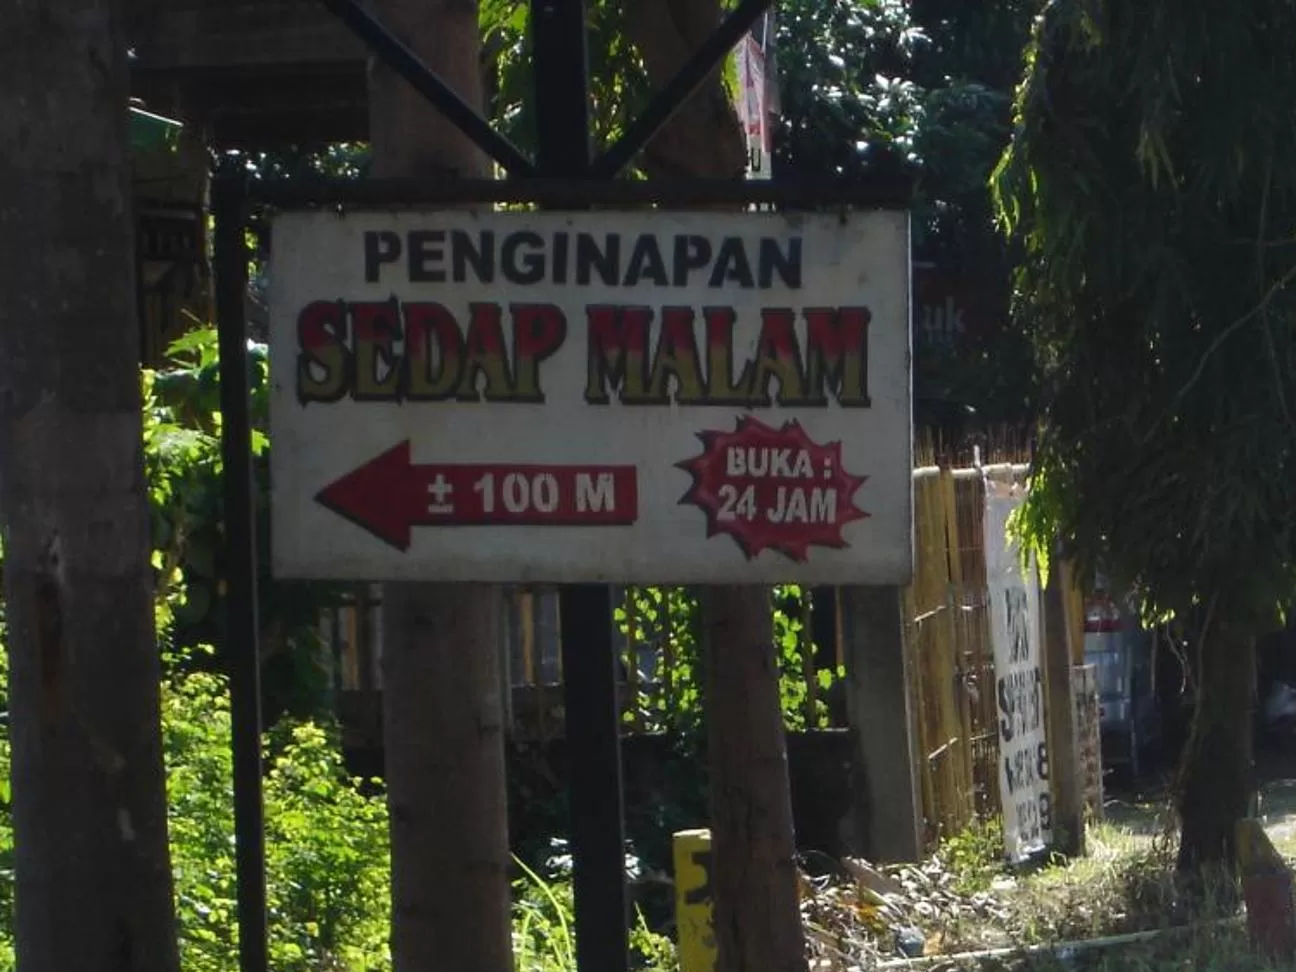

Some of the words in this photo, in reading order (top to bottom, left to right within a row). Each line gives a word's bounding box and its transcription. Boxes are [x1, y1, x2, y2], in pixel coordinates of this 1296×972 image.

[364, 231, 803, 288] PENGINAPAN
[298, 298, 566, 405] SEDAP
[584, 305, 872, 409] MALAM
[726, 446, 812, 480] BUKA
[474, 473, 558, 514] 100
[575, 473, 616, 514] M
[717, 484, 757, 522] 24
[767, 487, 838, 525] JAM
